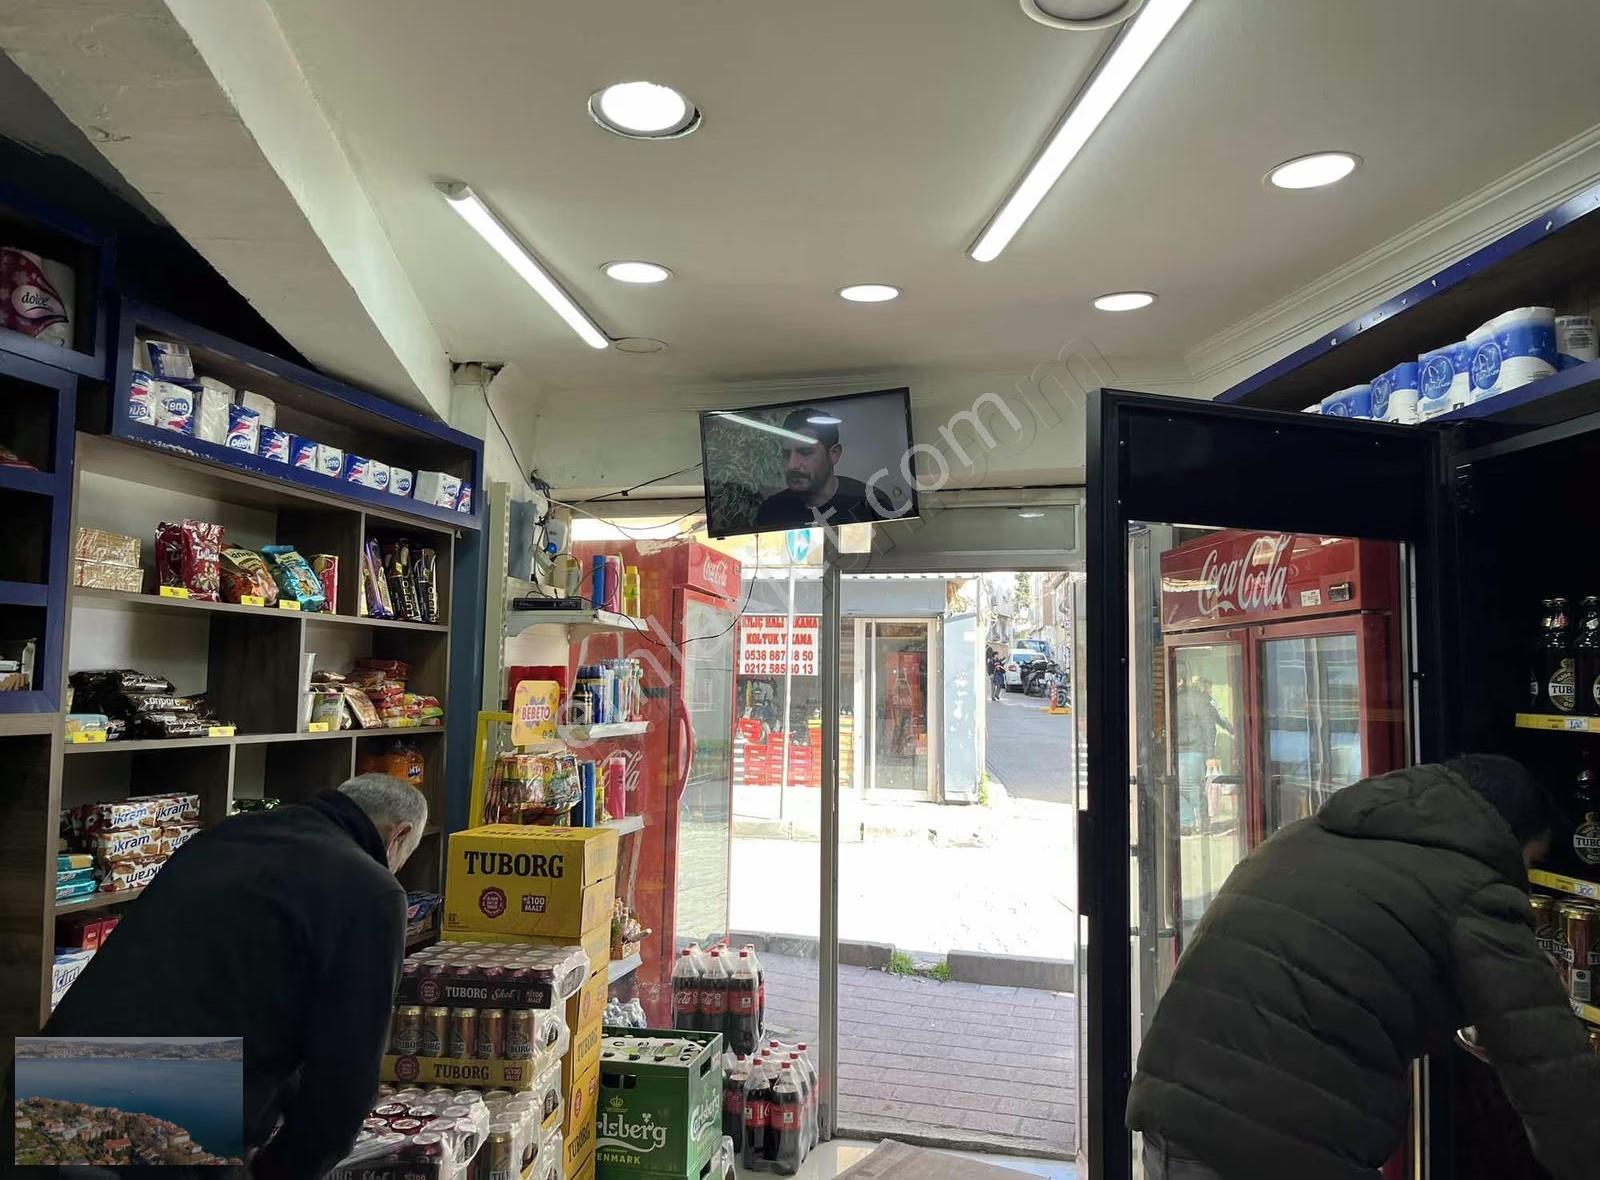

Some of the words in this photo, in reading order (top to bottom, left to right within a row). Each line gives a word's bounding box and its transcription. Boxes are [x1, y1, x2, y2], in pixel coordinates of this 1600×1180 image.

[746, 633, 779, 645] KOLTUK
[781, 633, 813, 645] YKAMA
[745, 650, 767, 662] 0538
[802, 650, 814, 662] 50
[744, 663, 767, 674] 0212
[769, 663, 786, 674] 585
[802, 664, 814, 675] 13
[521, 705, 551, 721] BEBETO
[156, 802, 190, 819] ikram
[113, 834, 150, 854] ikram
[464, 850, 565, 879] TUBORG
[445, 986, 488, 1000] TUBORG
[433, 1063, 490, 1081] TUBORG
[596, 1112, 668, 1148] lsberg
[597, 1152, 641, 1165] ENMARK
